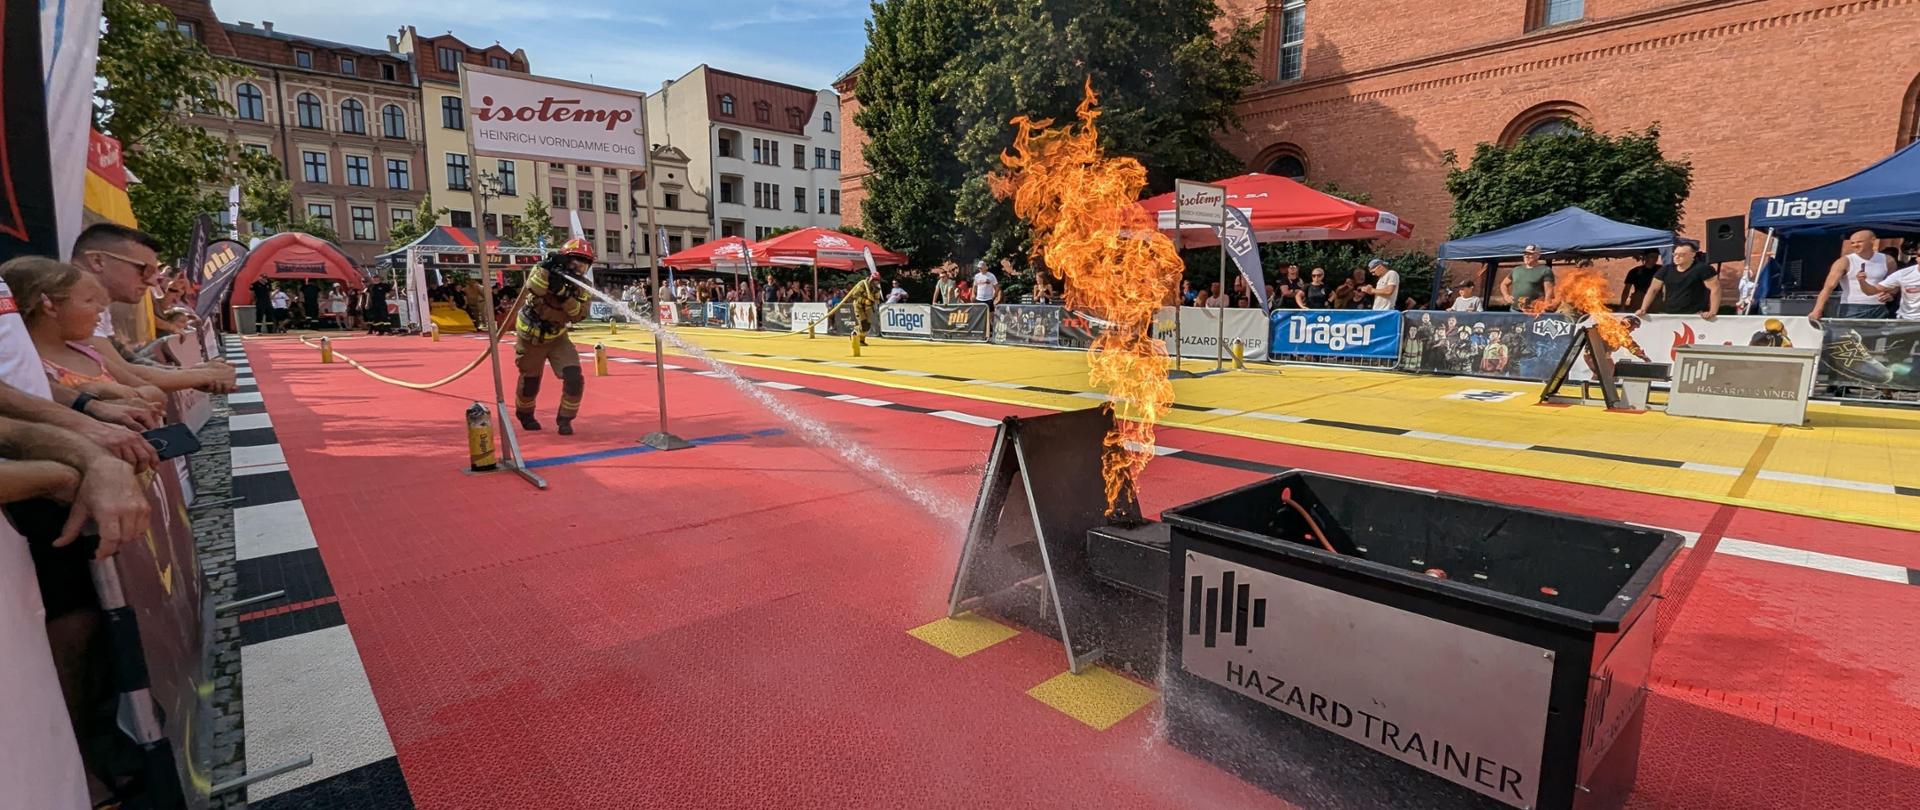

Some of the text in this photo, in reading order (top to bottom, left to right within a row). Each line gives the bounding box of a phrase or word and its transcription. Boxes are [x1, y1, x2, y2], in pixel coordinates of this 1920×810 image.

[478, 96, 633, 130] isotemp
[479, 128, 636, 155] HEINRICH VORNDAMME OHG
[1180, 192, 1221, 207] isotemp
[1766, 197, 1850, 219] Dräger
[203, 243, 236, 280] pbi
[887, 308, 925, 331] Dräger
[947, 309, 970, 326] pbi
[1289, 315, 1375, 351] Dräger
